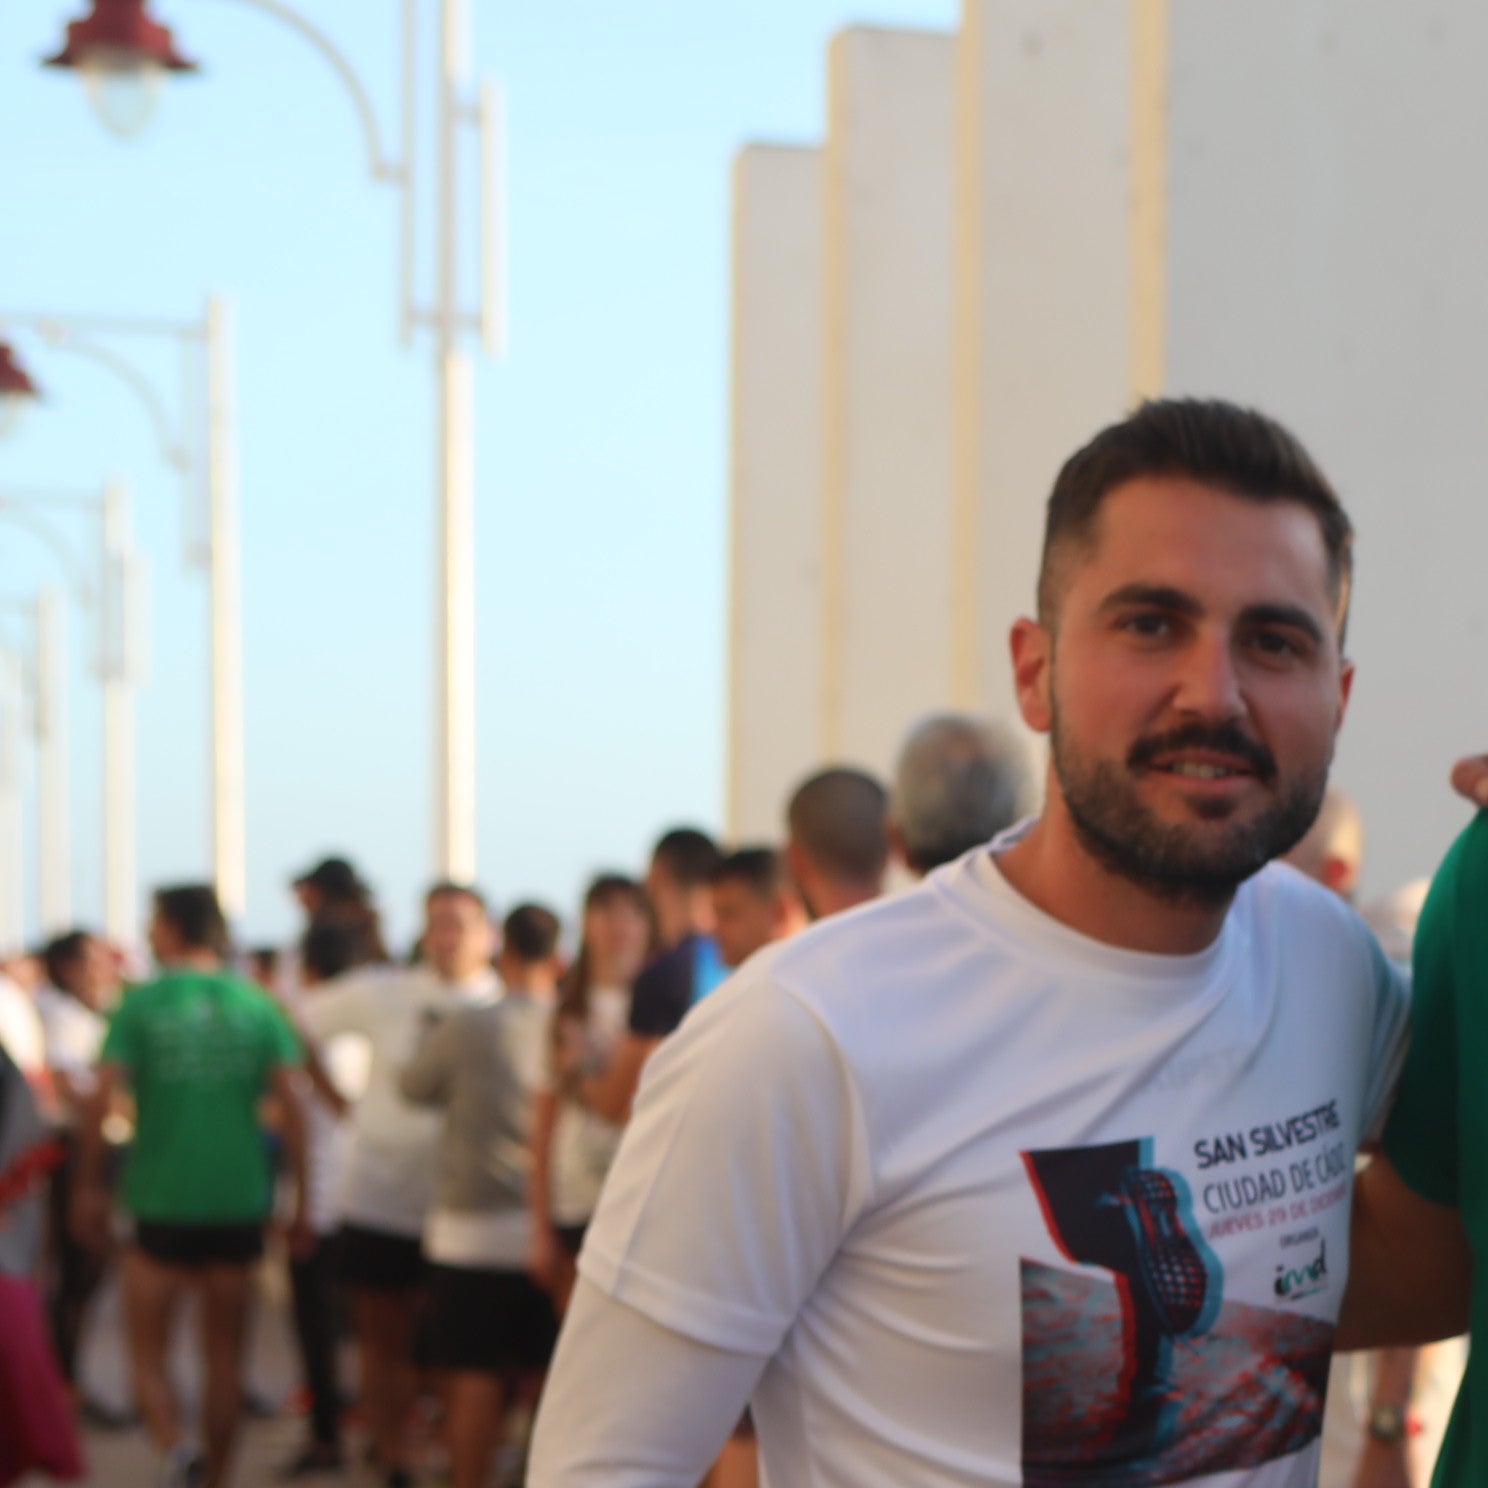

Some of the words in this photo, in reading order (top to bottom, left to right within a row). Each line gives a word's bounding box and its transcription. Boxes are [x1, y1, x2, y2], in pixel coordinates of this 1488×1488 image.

[1194, 1132, 1247, 1169] SAN
[1250, 1098, 1340, 1156] SILVESTRE
[1203, 1169, 1286, 1214] CIUDAD
[1289, 1159, 1314, 1193] DE
